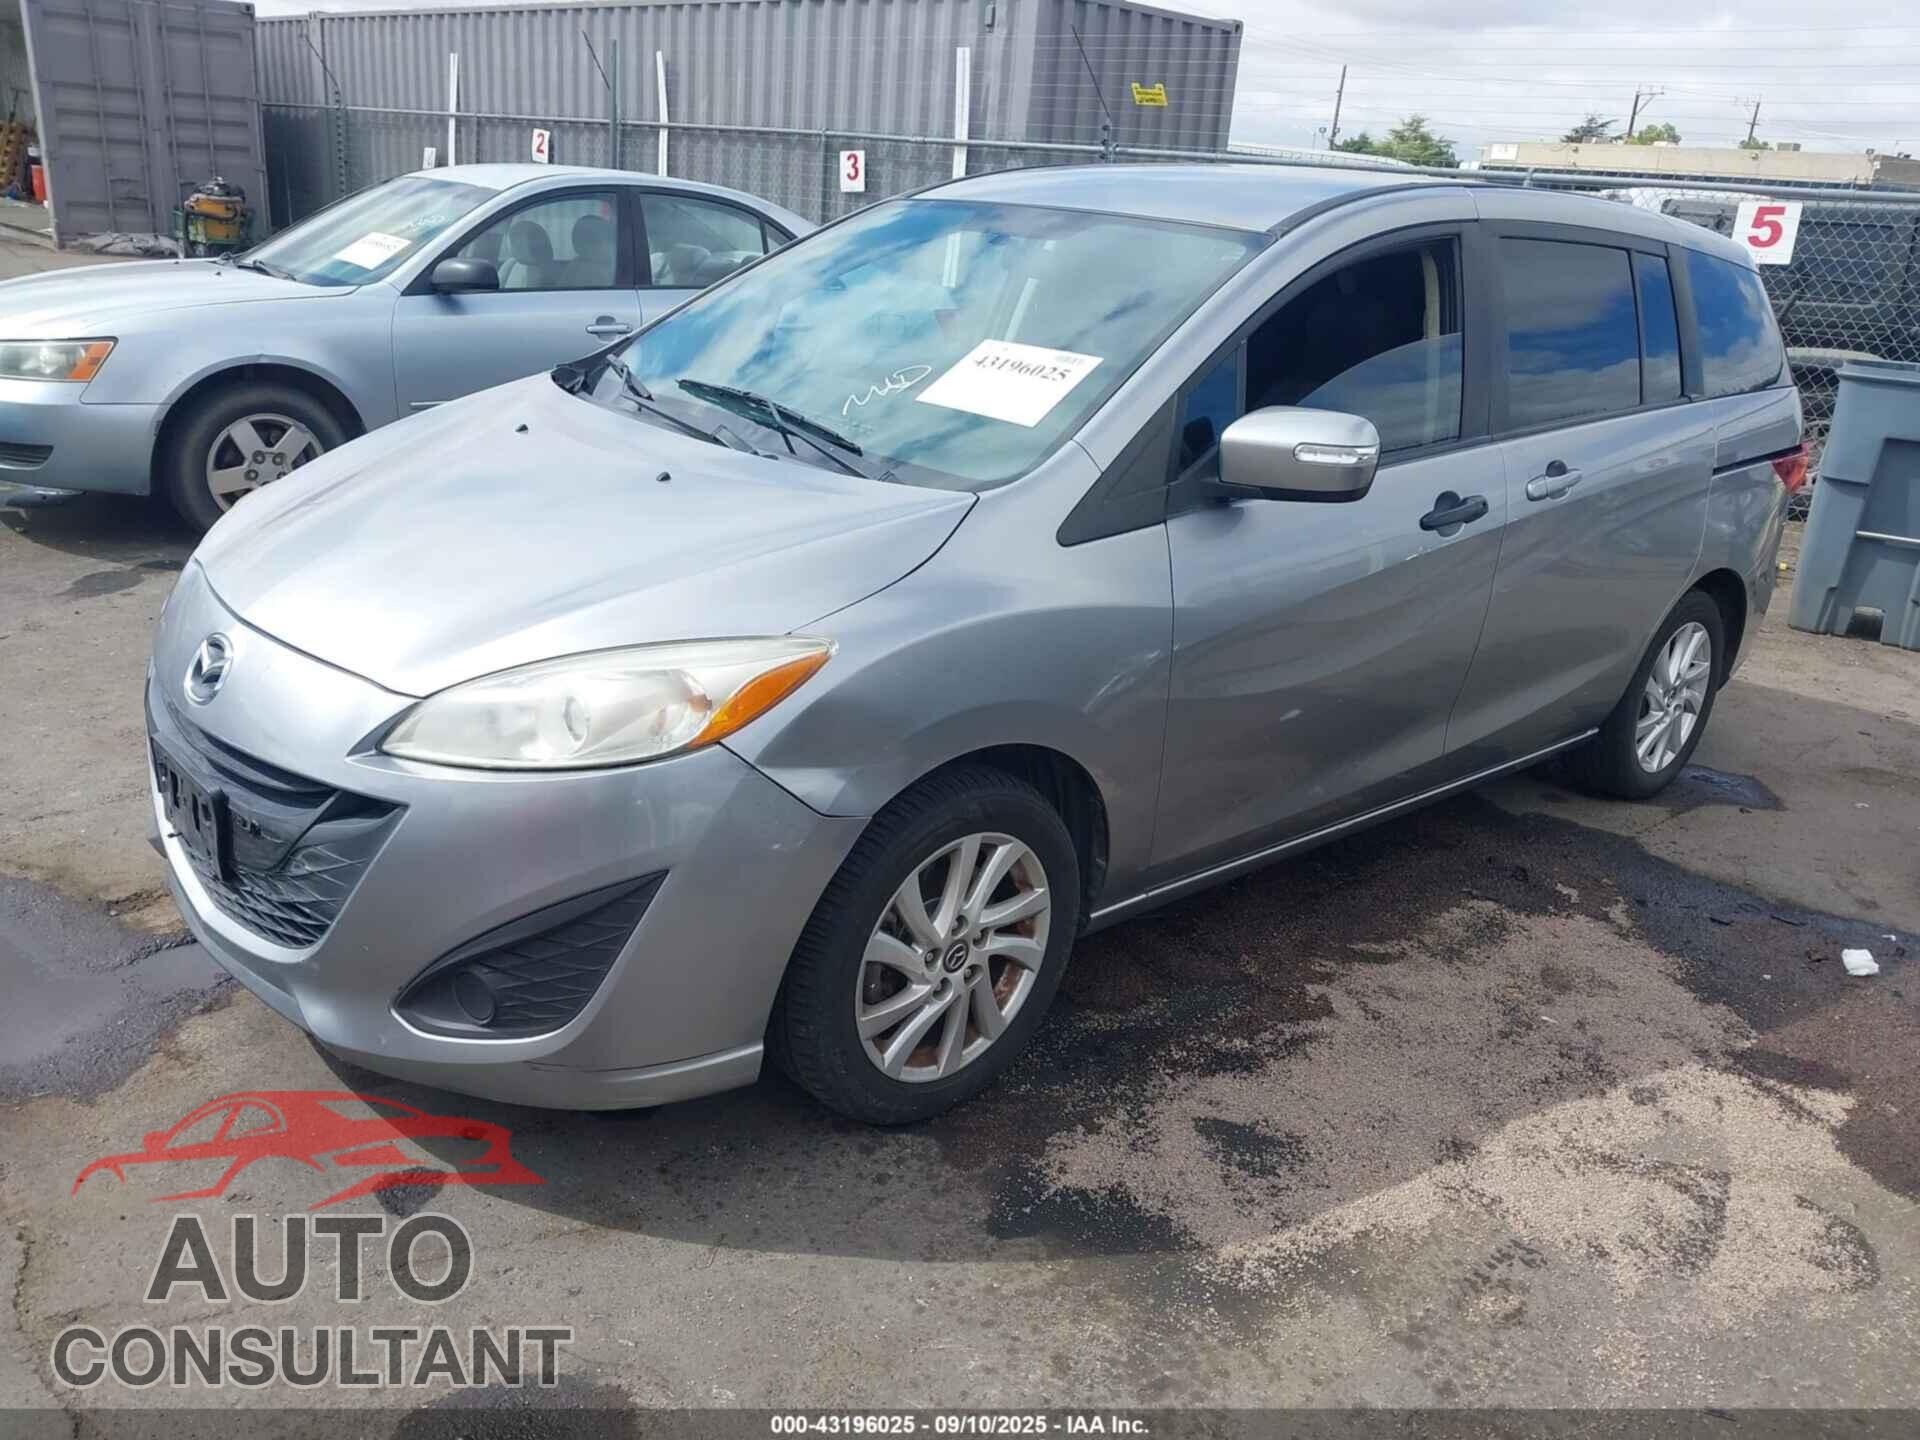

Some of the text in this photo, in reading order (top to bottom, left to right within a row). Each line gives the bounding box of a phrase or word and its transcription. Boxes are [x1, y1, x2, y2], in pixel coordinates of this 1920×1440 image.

[536, 132, 545, 154] 2
[846, 153, 859, 181] 3
[1747, 206, 1786, 249] 5
[974, 355, 1072, 382] 43196025
